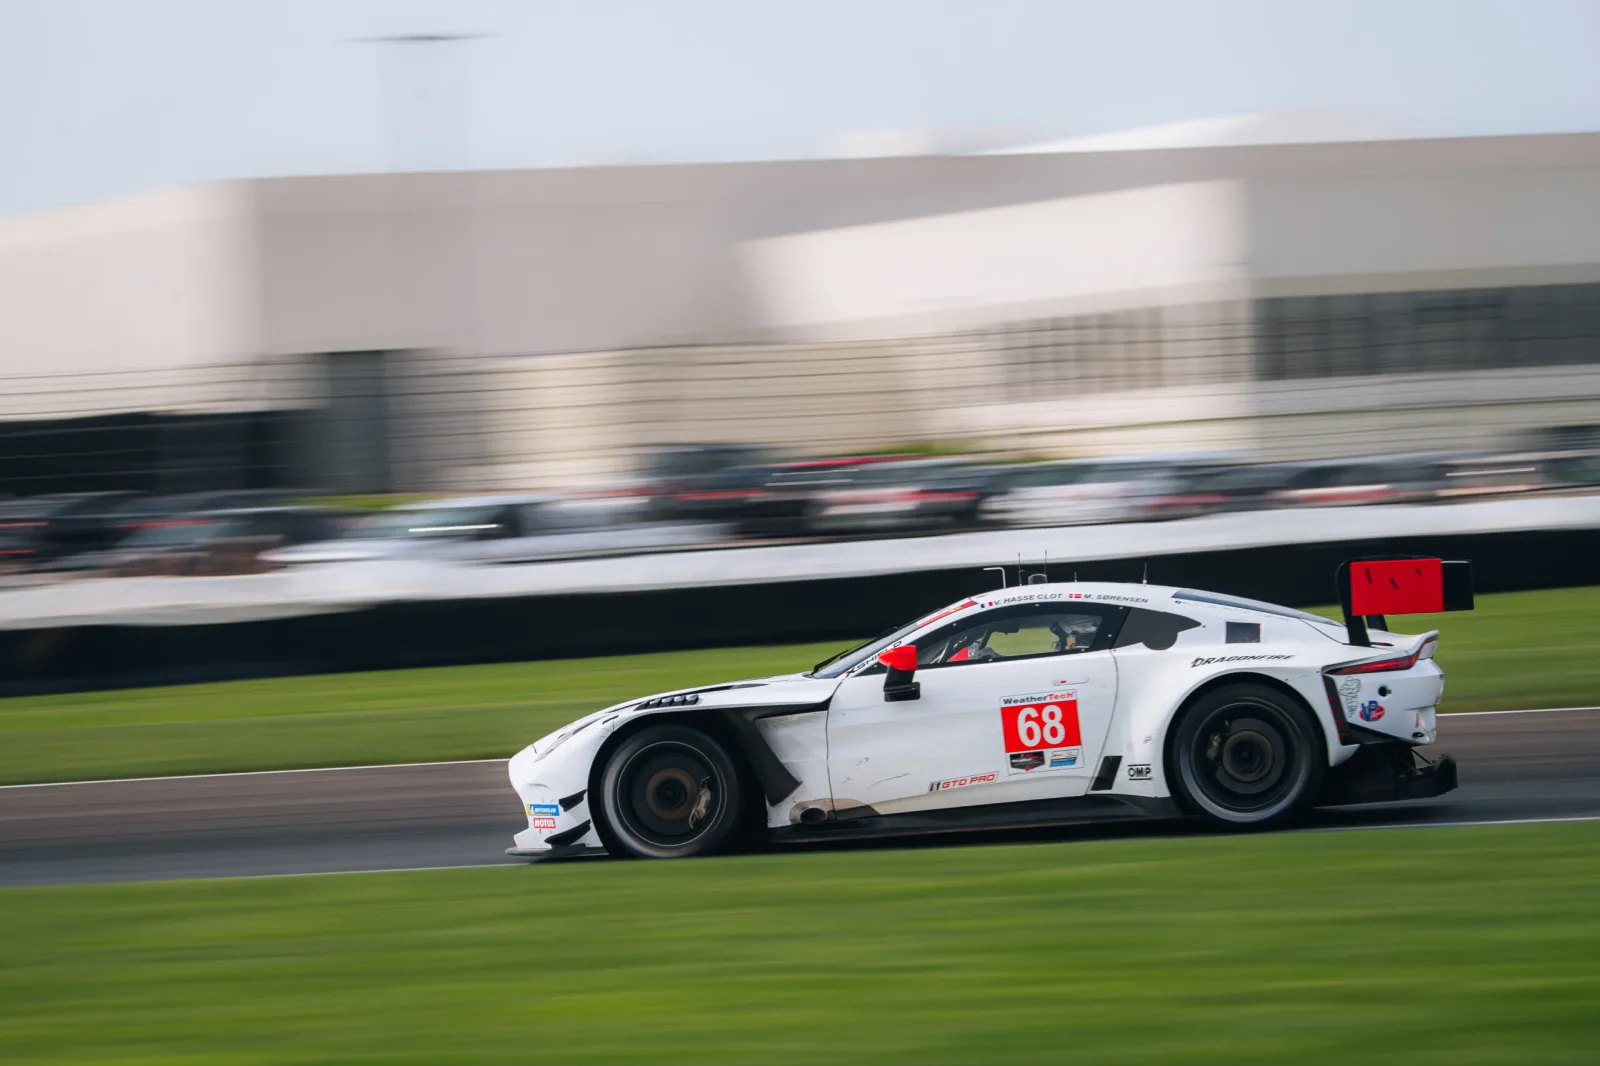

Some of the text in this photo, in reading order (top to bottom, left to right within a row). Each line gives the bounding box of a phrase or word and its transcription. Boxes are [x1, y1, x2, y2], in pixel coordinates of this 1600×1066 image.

[1003, 594, 1036, 604] HASSE
[1096, 594, 1149, 604] SØRENSEN
[1190, 654, 1297, 668] DRAGONFIRE
[1361, 700, 1379, 722] VP
[1017, 704, 1066, 748] 68
[1128, 766, 1151, 777] OMP
[941, 773, 996, 789] GTD PRO
[535, 819, 555, 828] MOTUL
